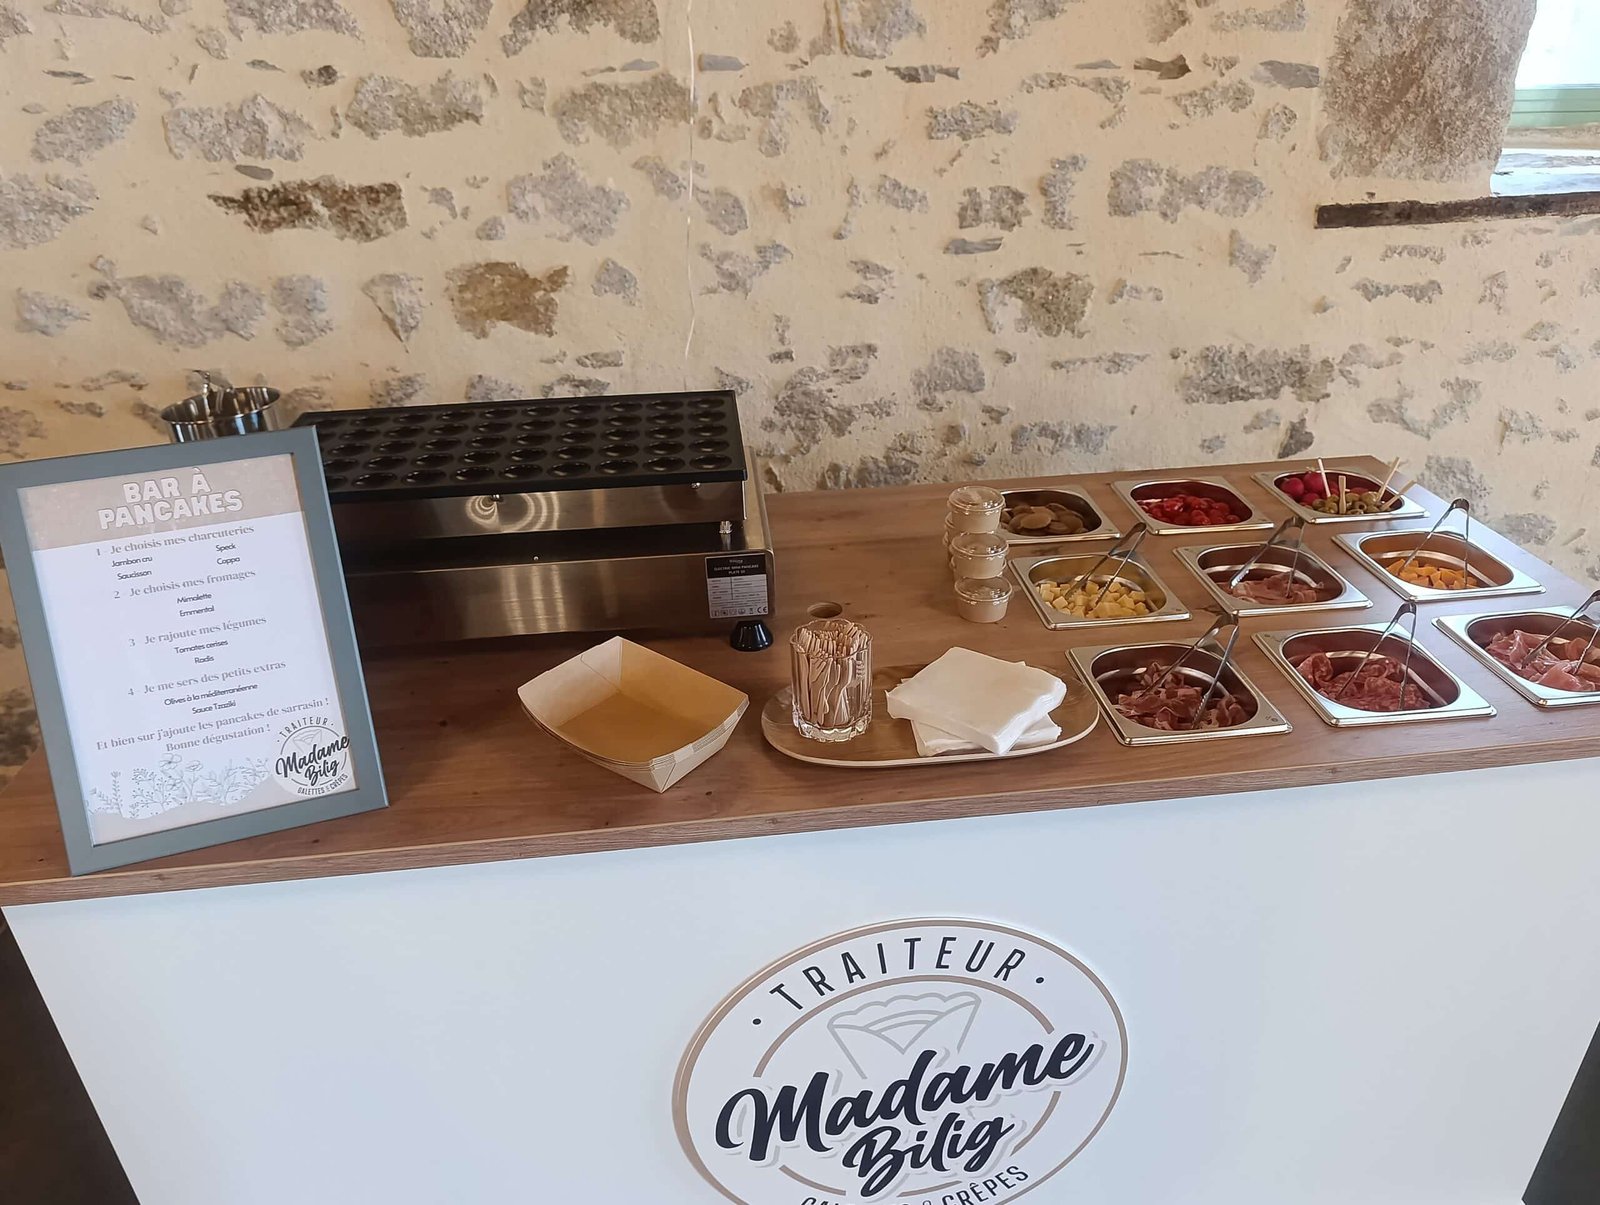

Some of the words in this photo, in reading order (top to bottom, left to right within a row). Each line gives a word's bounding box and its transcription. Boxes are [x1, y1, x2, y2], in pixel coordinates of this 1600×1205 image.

[122, 476, 181, 504] BAR
[191, 467, 213, 494] À
[97, 490, 244, 530] PANCAKES
[110, 544, 122, 555] Je
[125, 539, 162, 553] choisis
[163, 537, 187, 547] mes
[188, 525, 255, 543] charcuteries
[215, 543, 237, 553] Speck
[111, 557, 141, 568] Jambon
[216, 556, 241, 566] Coppa
[117, 569, 153, 580] Saucisson
[129, 587, 141, 597] Je
[143, 582, 181, 595] choisis
[182, 579, 205, 589] mes
[206, 569, 257, 585] fromages
[176, 592, 213, 604] Mimolette
[179, 605, 215, 617] Emmental
[144, 635, 157, 645] Je
[158, 628, 198, 643] rajoute
[199, 625, 222, 635] mes
[223, 616, 268, 631] légumes
[174, 644, 205, 654] Tomates
[205, 640, 229, 648] cerises
[194, 655, 215, 664] Radis
[127, 687, 135, 696] 4
[143, 684, 155, 694] Je
[157, 681, 175, 692] me
[176, 678, 199, 687] sers
[200, 672, 220, 684] des
[221, 666, 252, 683] petits
[253, 661, 287, 674] extras
[164, 698, 187, 706] Olives
[200, 683, 258, 699] méditerranéenne
[191, 706, 213, 715] Sauce
[96, 740, 110, 752] Et
[111, 735, 136, 749] bien
[137, 732, 157, 743] sur
[157, 723, 197, 741] j'ajoute
[198, 719, 214, 731] les
[215, 710, 266, 730] pancakes
[266, 706, 280, 718] de
[281, 700, 324, 714] sarrasin
[279, 716, 329, 738] TRAITEUR
[165, 740, 201, 753] Bonne
[201, 727, 265, 748] dégustation
[275, 736, 350, 778] Madame
[304, 760, 340, 787] Bilig
[297, 786, 325, 796] GALETTES
[769, 936, 1027, 1010] TRAITEUR
[715, 1032, 1095, 1161] Madame
[842, 1112, 1015, 1198] Bilig
[941, 1166, 1029, 1205] CRÊPES
